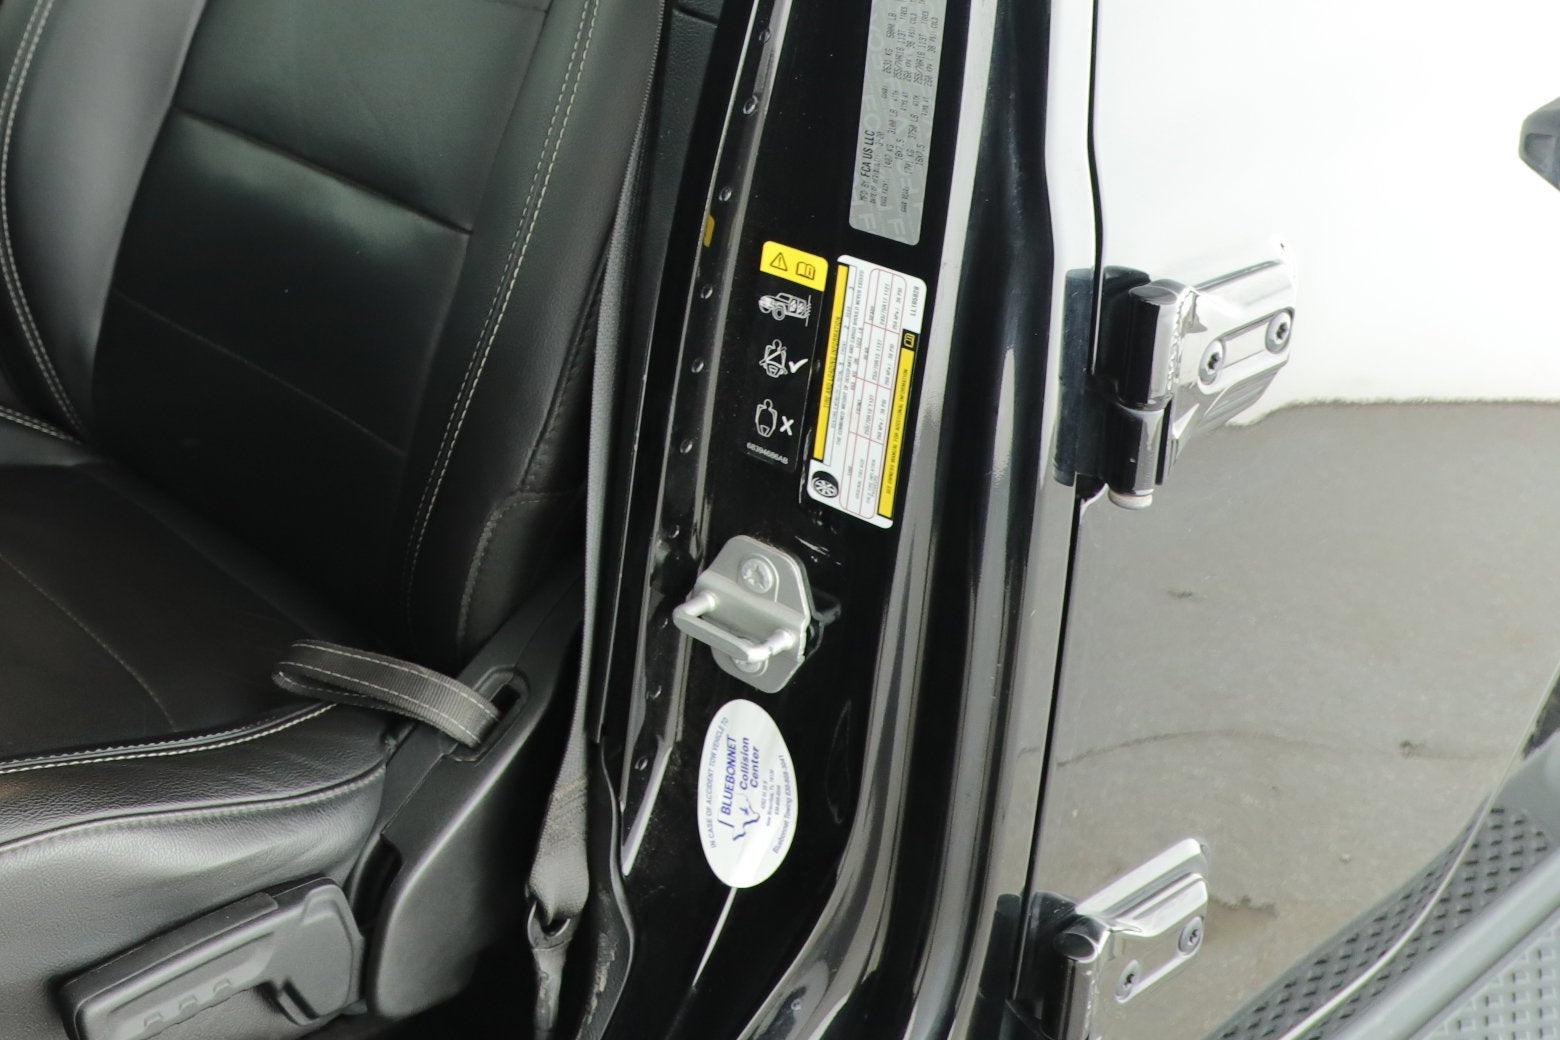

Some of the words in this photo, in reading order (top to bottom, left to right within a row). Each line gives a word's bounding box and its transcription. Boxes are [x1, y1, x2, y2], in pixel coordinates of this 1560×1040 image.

[863, 129, 875, 146] LLC
[862, 147, 873, 160] US
[860, 161, 871, 178] FCA
[831, 316, 841, 355] INFORMATION
[827, 356, 836, 382] LOADING
[720, 716, 729, 725] TO
[713, 725, 724, 751] VEHICLE
[709, 751, 717, 767] TOW
[739, 737, 749, 790] Collision
[750, 746, 760, 788] Center
[705, 769, 716, 805] ACCIDENT
[721, 735, 737, 816] BLUEBONNET
[706, 807, 713, 817] OF
[705, 818, 716, 839] CASE
[773, 820, 788, 854] Bluebonnet
[783, 797, 793, 819] Towing
